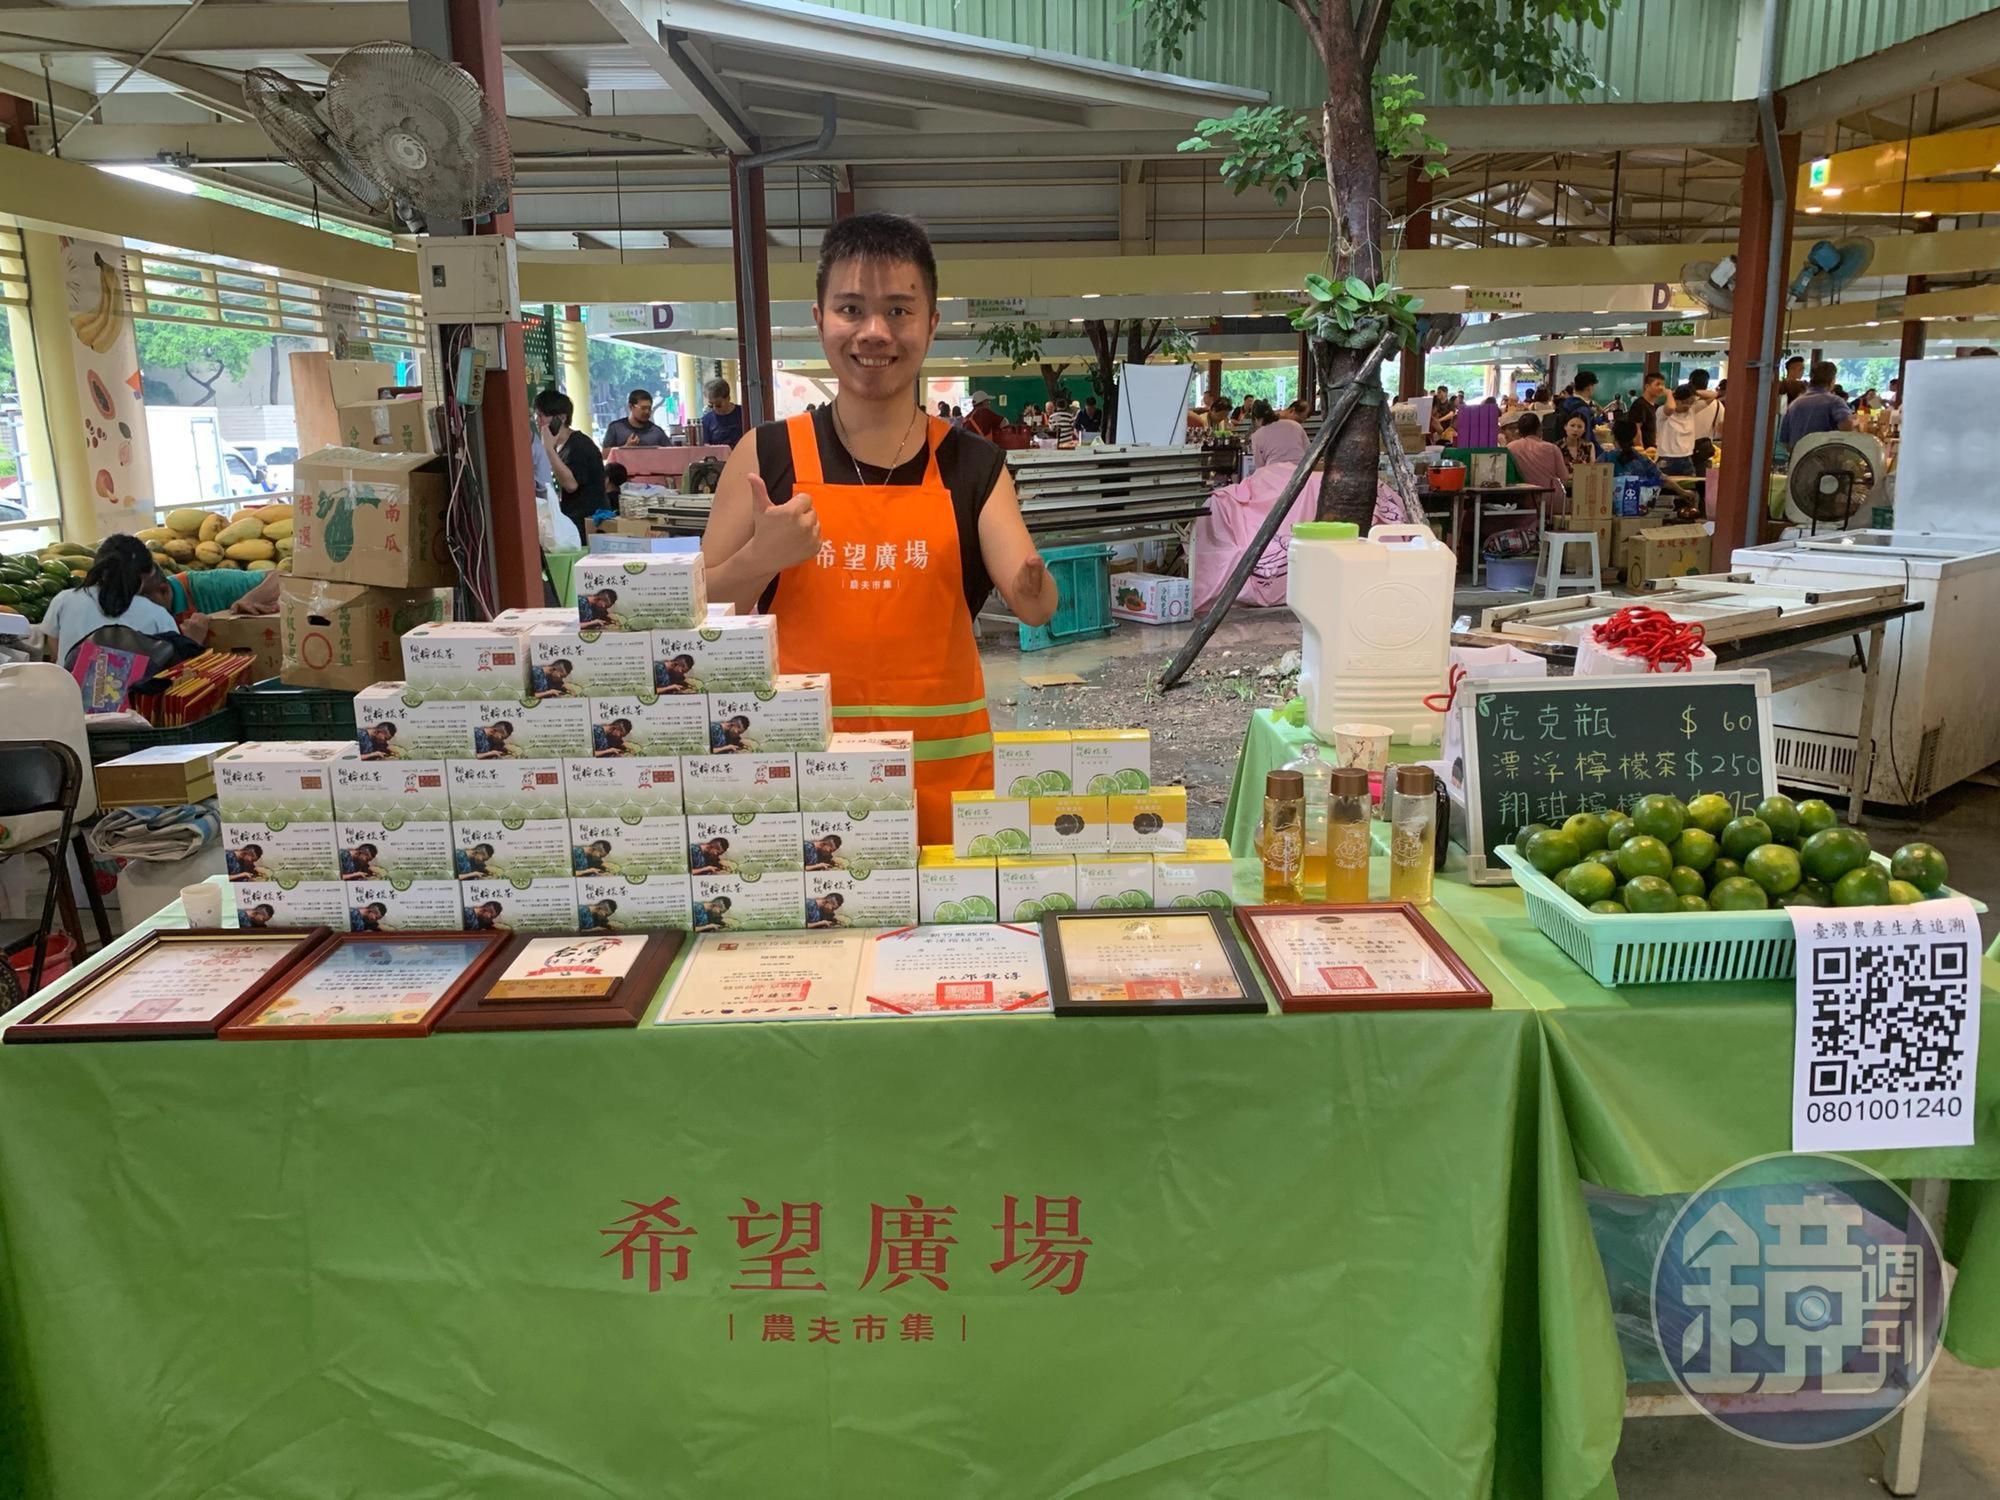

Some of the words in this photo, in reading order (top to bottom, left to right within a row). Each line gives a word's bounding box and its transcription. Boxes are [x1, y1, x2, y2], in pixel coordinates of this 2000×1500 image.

[1652, 282, 1671, 310] D
[652, 304, 674, 329] D
[1610, 338, 1624, 352] A
[385, 503, 401, 553] 南瓜
[816, 540, 928, 572] 希望廣場
[1492, 703, 1617, 741] 虎克瓶
[1492, 750, 1677, 784] 漂浮檸檬茶
[1683, 748, 1760, 782] $250
[1498, 789, 1676, 828] 翔琪檸檬
[1812, 918, 1967, 940] 臺灣農產生產追溯
[1806, 1096, 1963, 1124] 0801001240
[600, 1194, 1094, 1296] 希望廣場
[760, 1313, 935, 1344] 農夫市集
